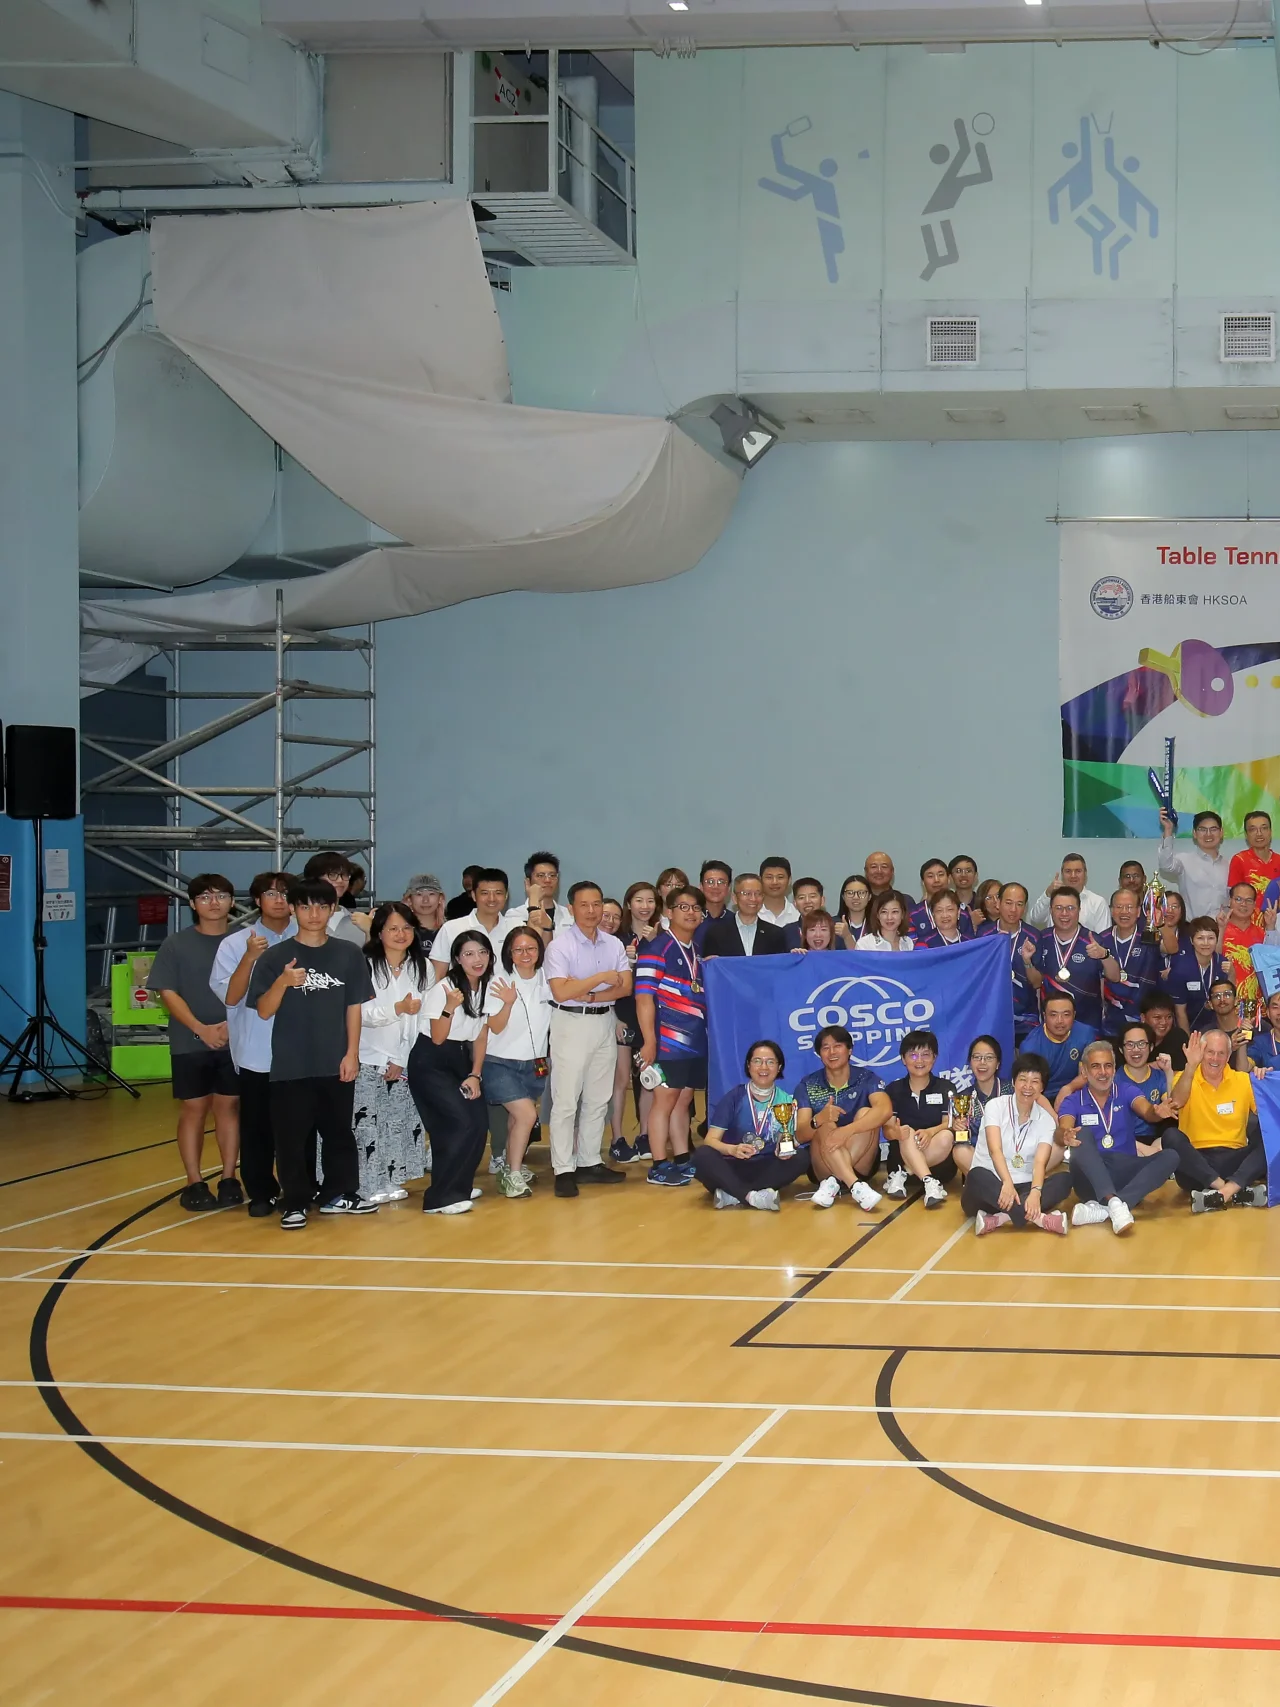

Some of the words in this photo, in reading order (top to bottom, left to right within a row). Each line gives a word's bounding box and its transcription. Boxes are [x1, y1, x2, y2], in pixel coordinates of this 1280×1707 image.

[499, 83, 516, 108] AC2
[1156, 546, 1217, 565] Table
[1140, 594, 1199, 605] 香港船東會
[1203, 595, 1248, 606] HKSOA
[788, 998, 935, 1031] COSCO
